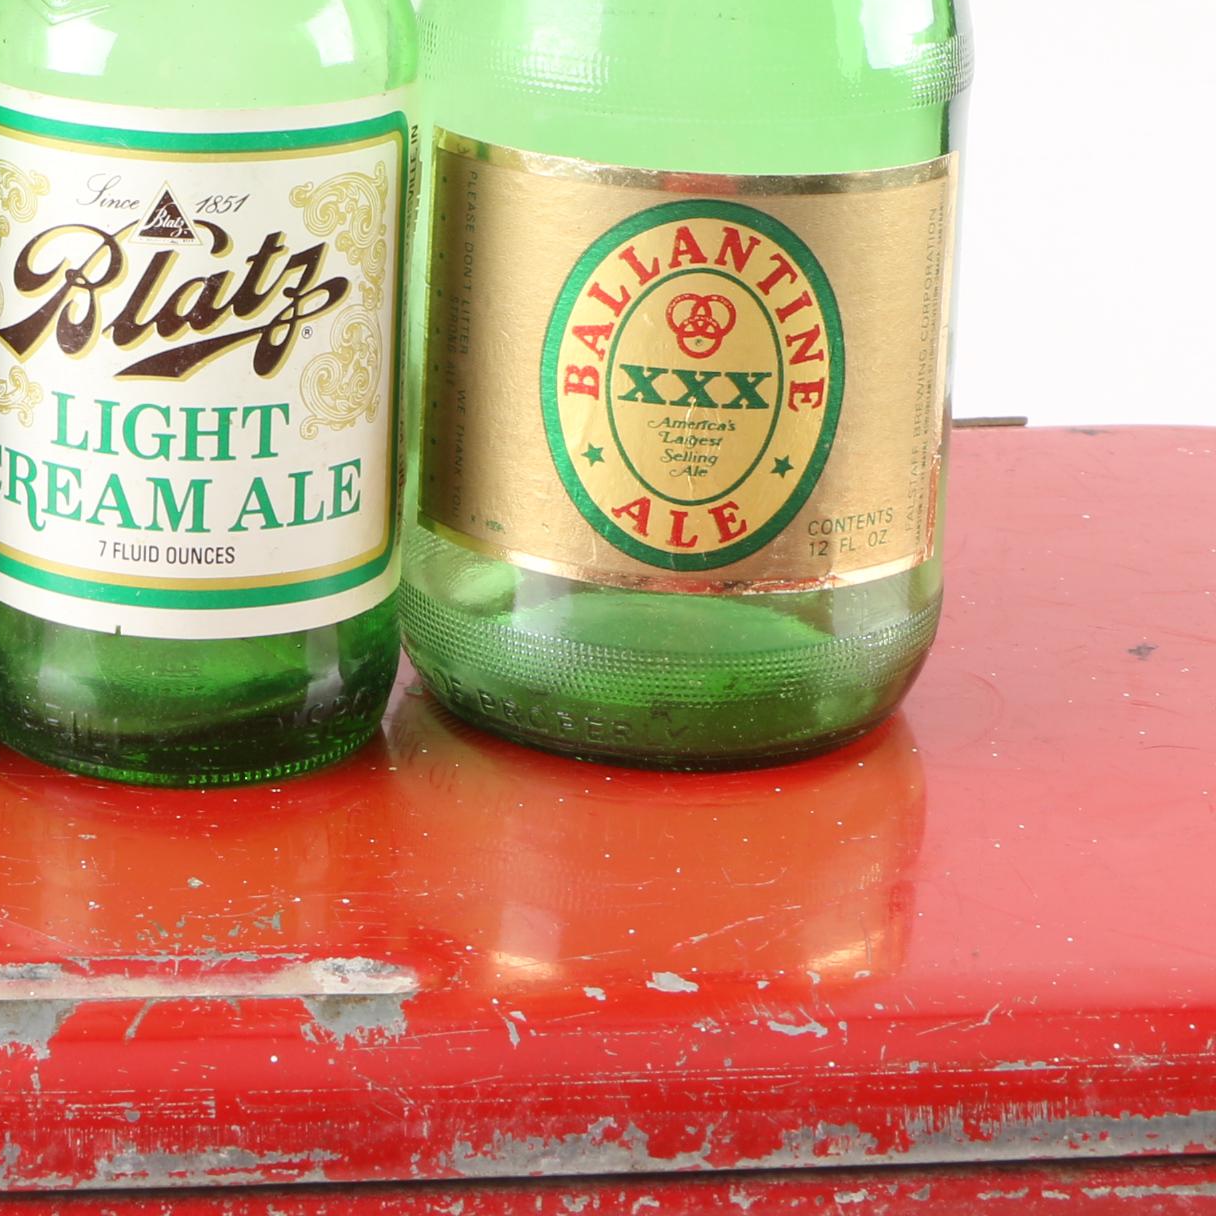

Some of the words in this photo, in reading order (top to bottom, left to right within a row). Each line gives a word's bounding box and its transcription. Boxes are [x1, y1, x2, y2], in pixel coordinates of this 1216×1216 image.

[75, 173, 140, 211] Since
[195, 194, 251, 215] 1851
[465, 170, 478, 233] PLEASE
[459, 300, 471, 354] LITTER
[563, 226, 826, 412] BALLANTINE
[912, 349, 928, 437] BREWING
[920, 208, 936, 342] CORPORATION
[618, 364, 772, 409] XXX
[51, 391, 290, 460] LIGHT
[453, 424, 465, 477] THANK
[660, 448, 718, 467] Selling
[669, 467, 708, 478] Ale
[227, 458, 362, 533] ALE
[611, 496, 748, 548] ALE
[807, 507, 894, 538] CONTENTS
[807, 539, 829, 557] 12
[98, 541, 108, 559] 7
[113, 543, 160, 563] FLUID
[166, 545, 236, 565] OUNCES
